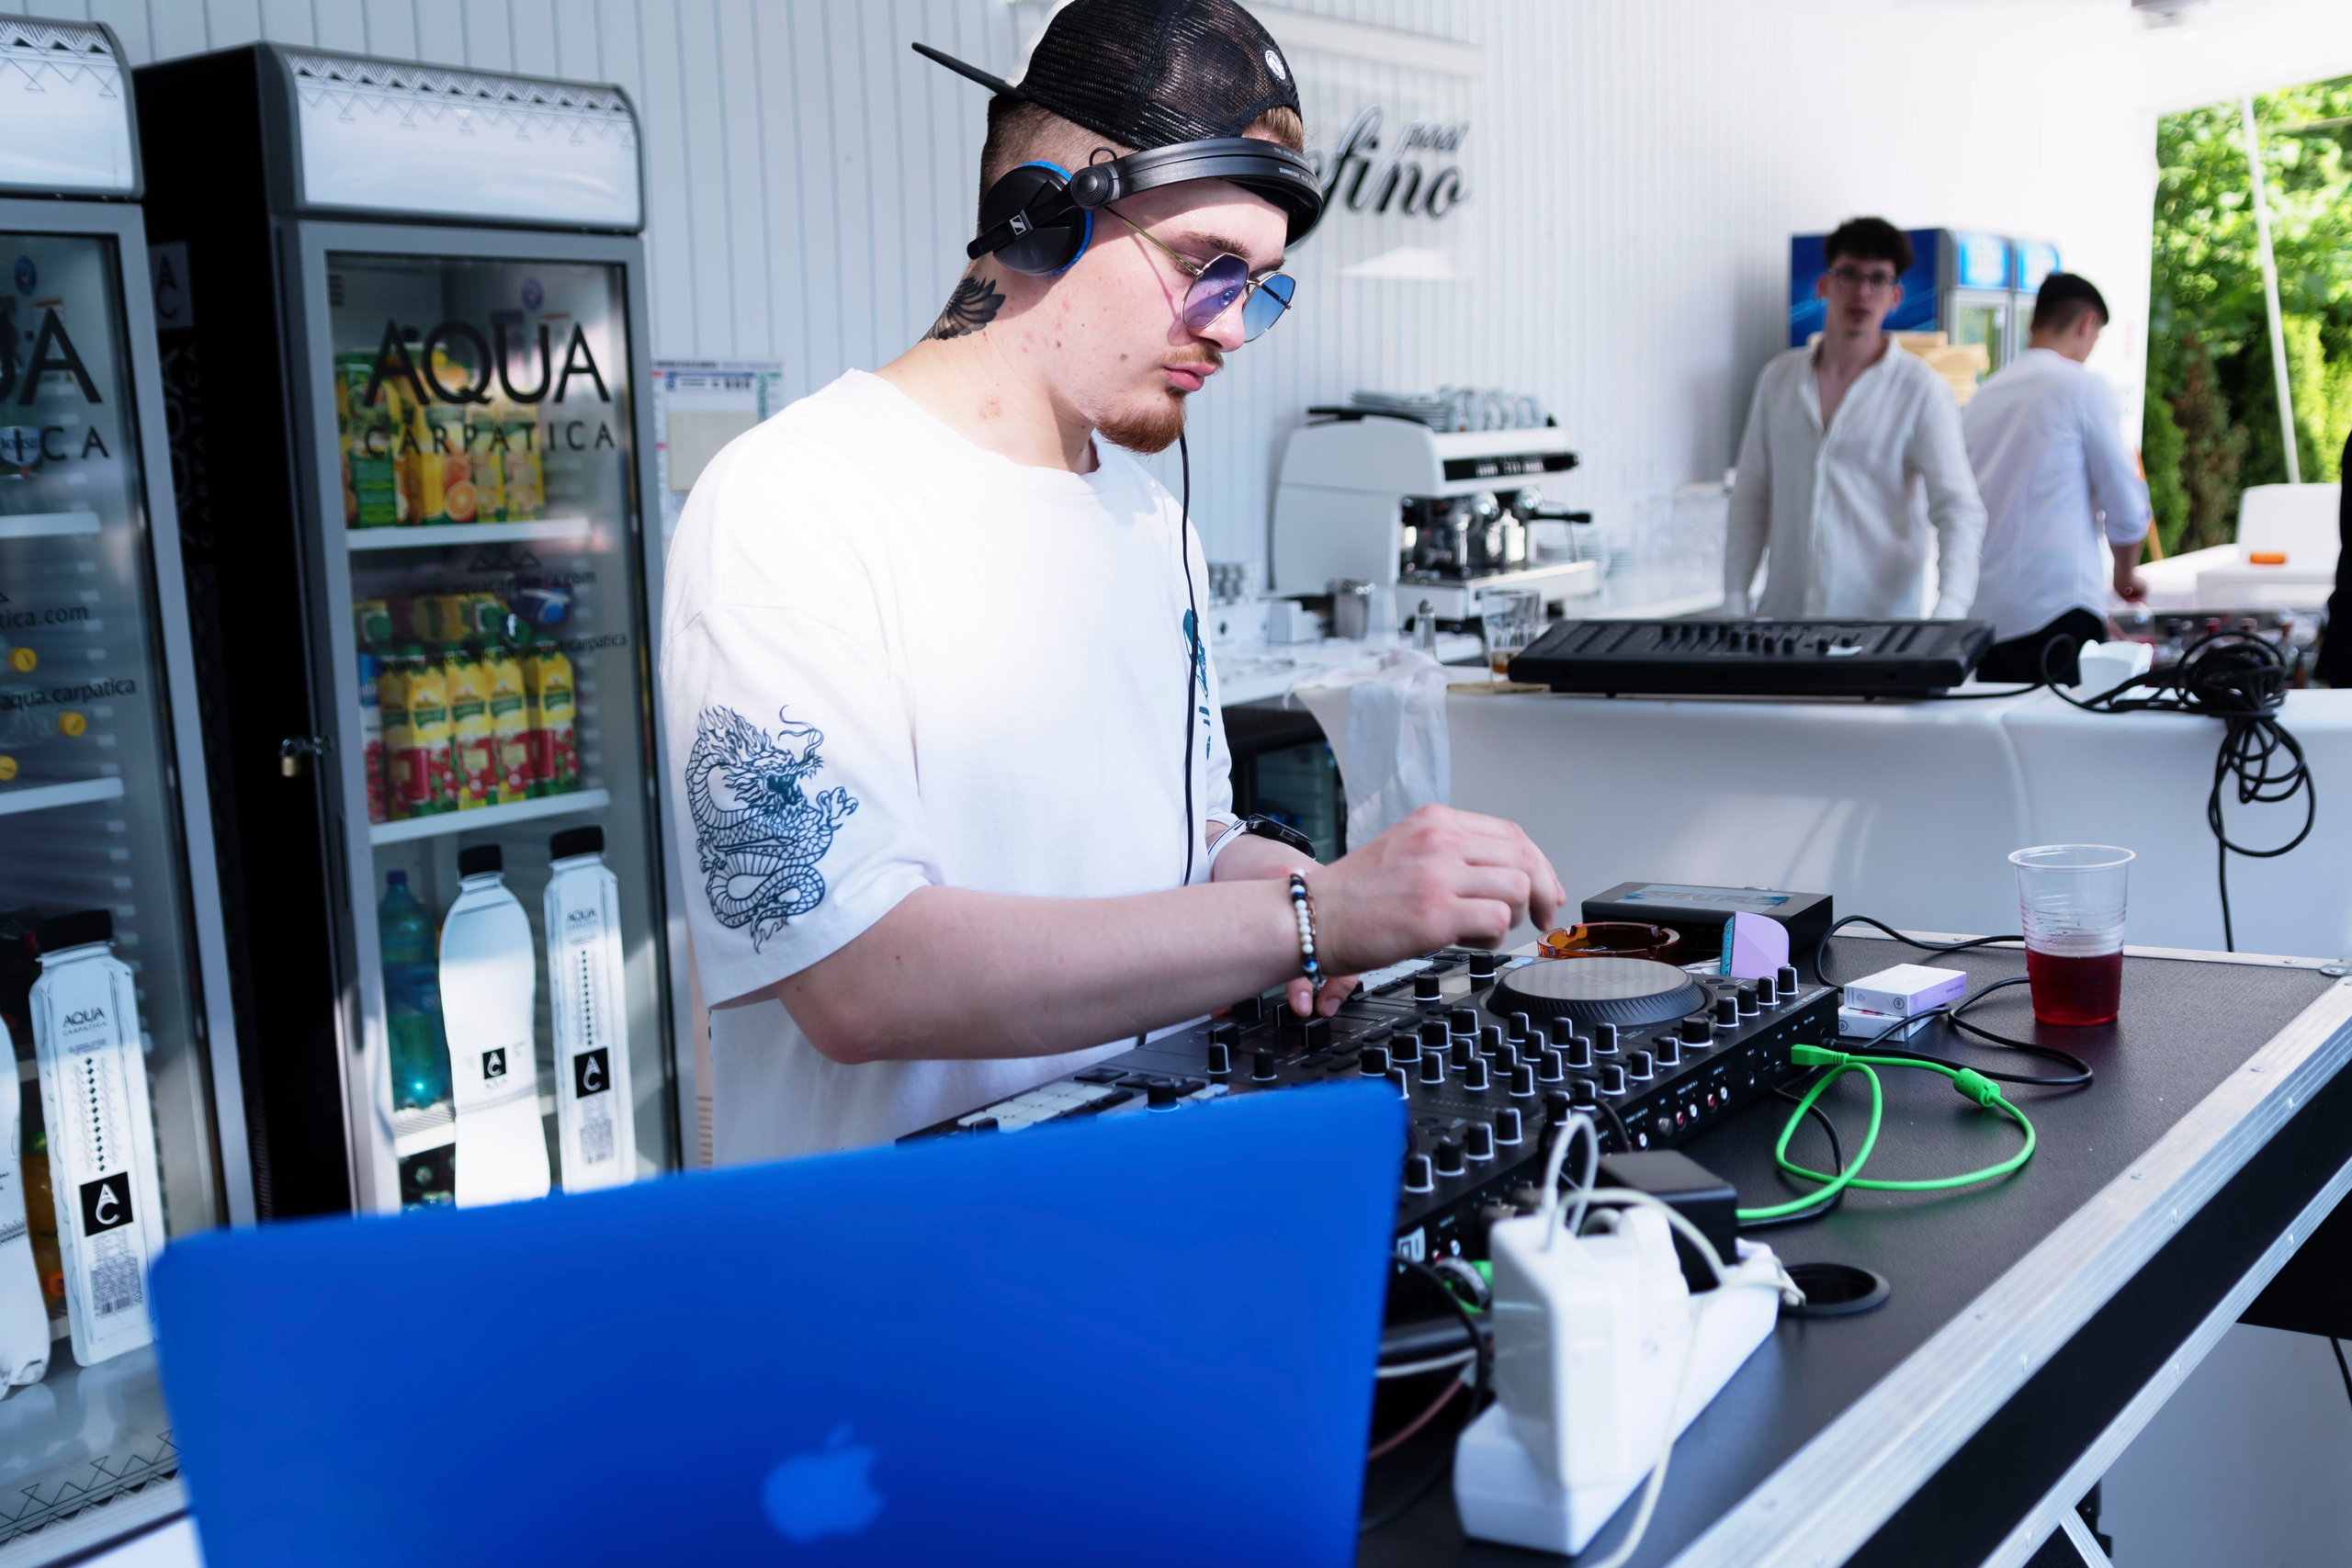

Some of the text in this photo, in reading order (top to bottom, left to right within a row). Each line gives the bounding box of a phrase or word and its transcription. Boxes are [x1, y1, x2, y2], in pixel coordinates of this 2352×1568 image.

[363, 319, 611, 406] AQUA
[364, 420, 616, 457] CARPATICA
[62, 1007, 105, 1028] AQUA
